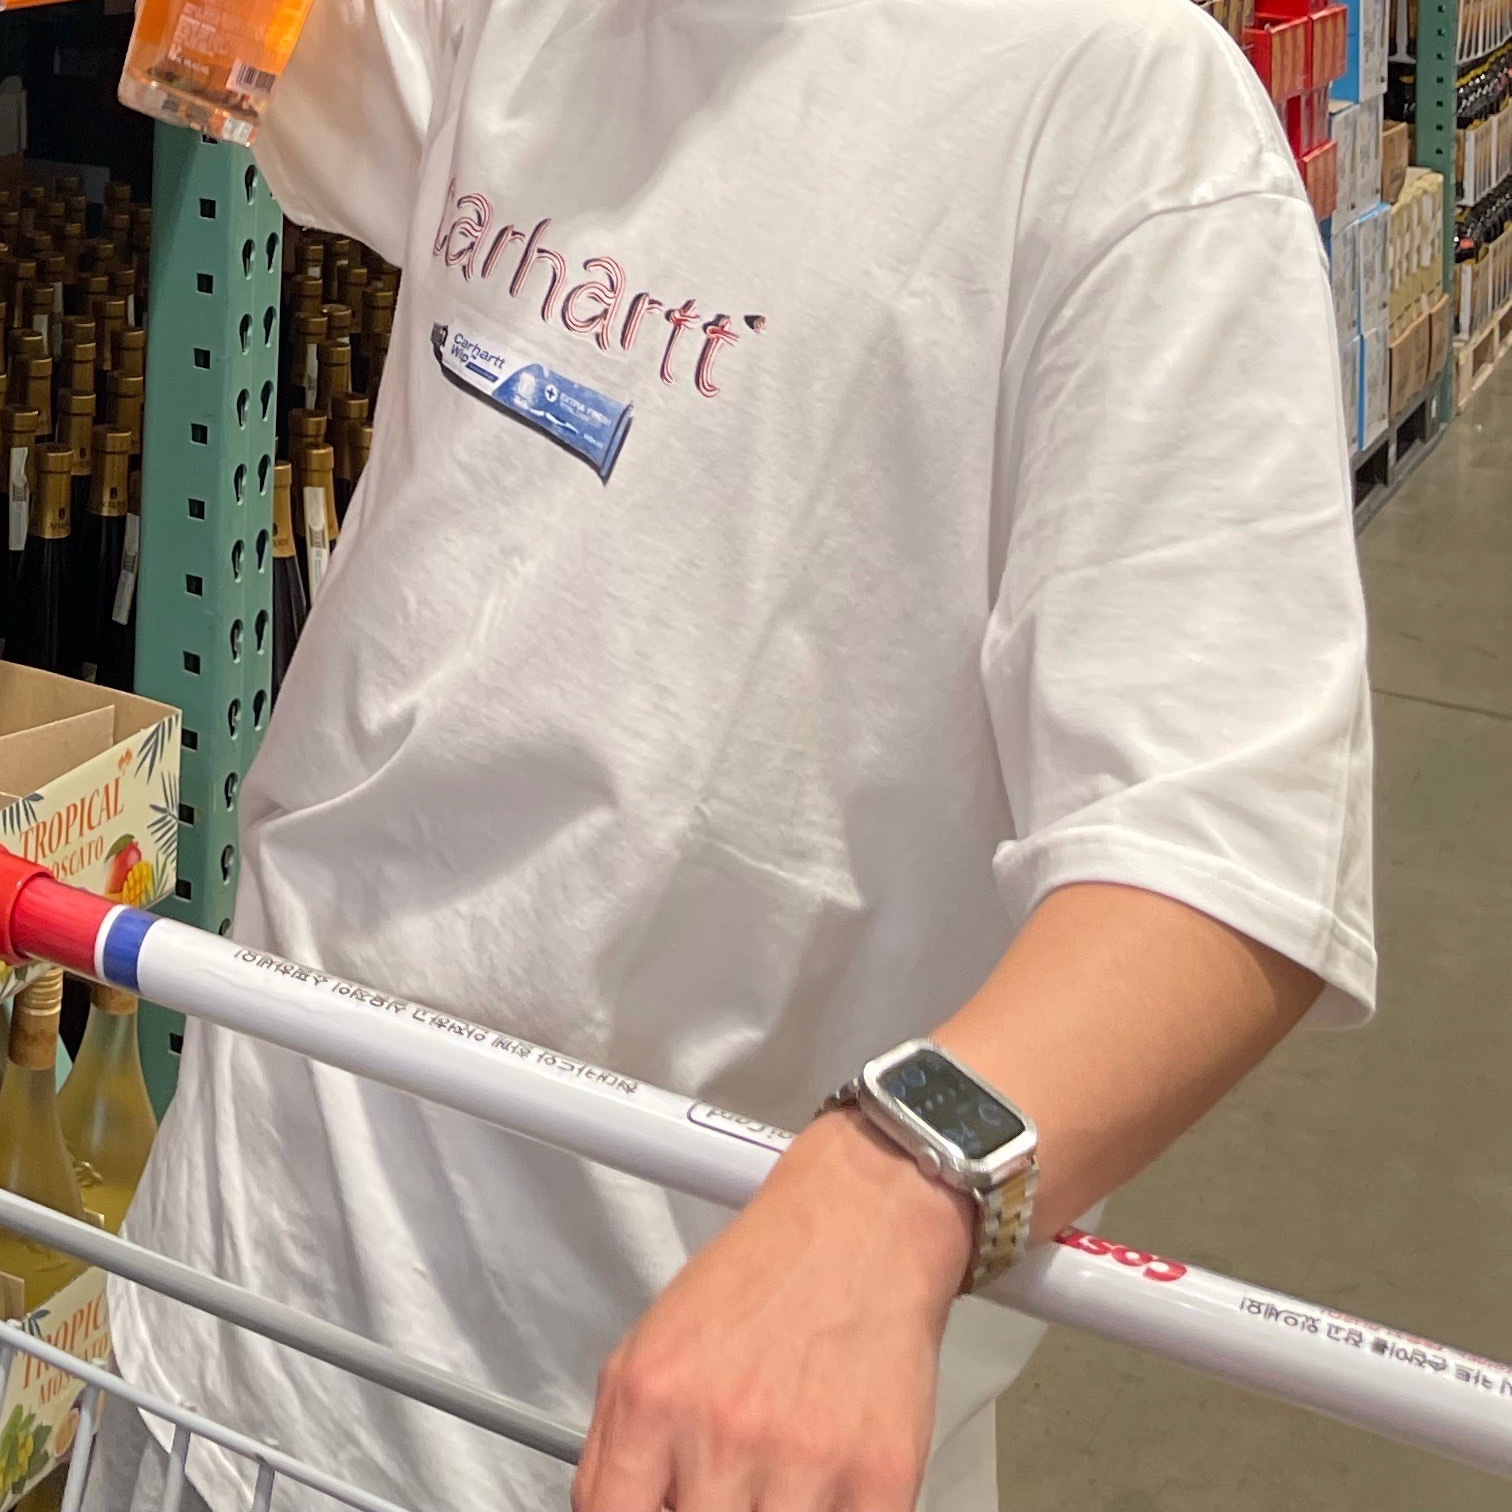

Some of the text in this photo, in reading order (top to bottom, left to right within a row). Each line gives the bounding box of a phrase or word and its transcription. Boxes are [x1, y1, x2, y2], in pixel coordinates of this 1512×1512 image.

[454, 333, 506, 369] Carhartt
[20, 777, 126, 865] TROPICAL
[45, 835, 105, 884] OSCATO
